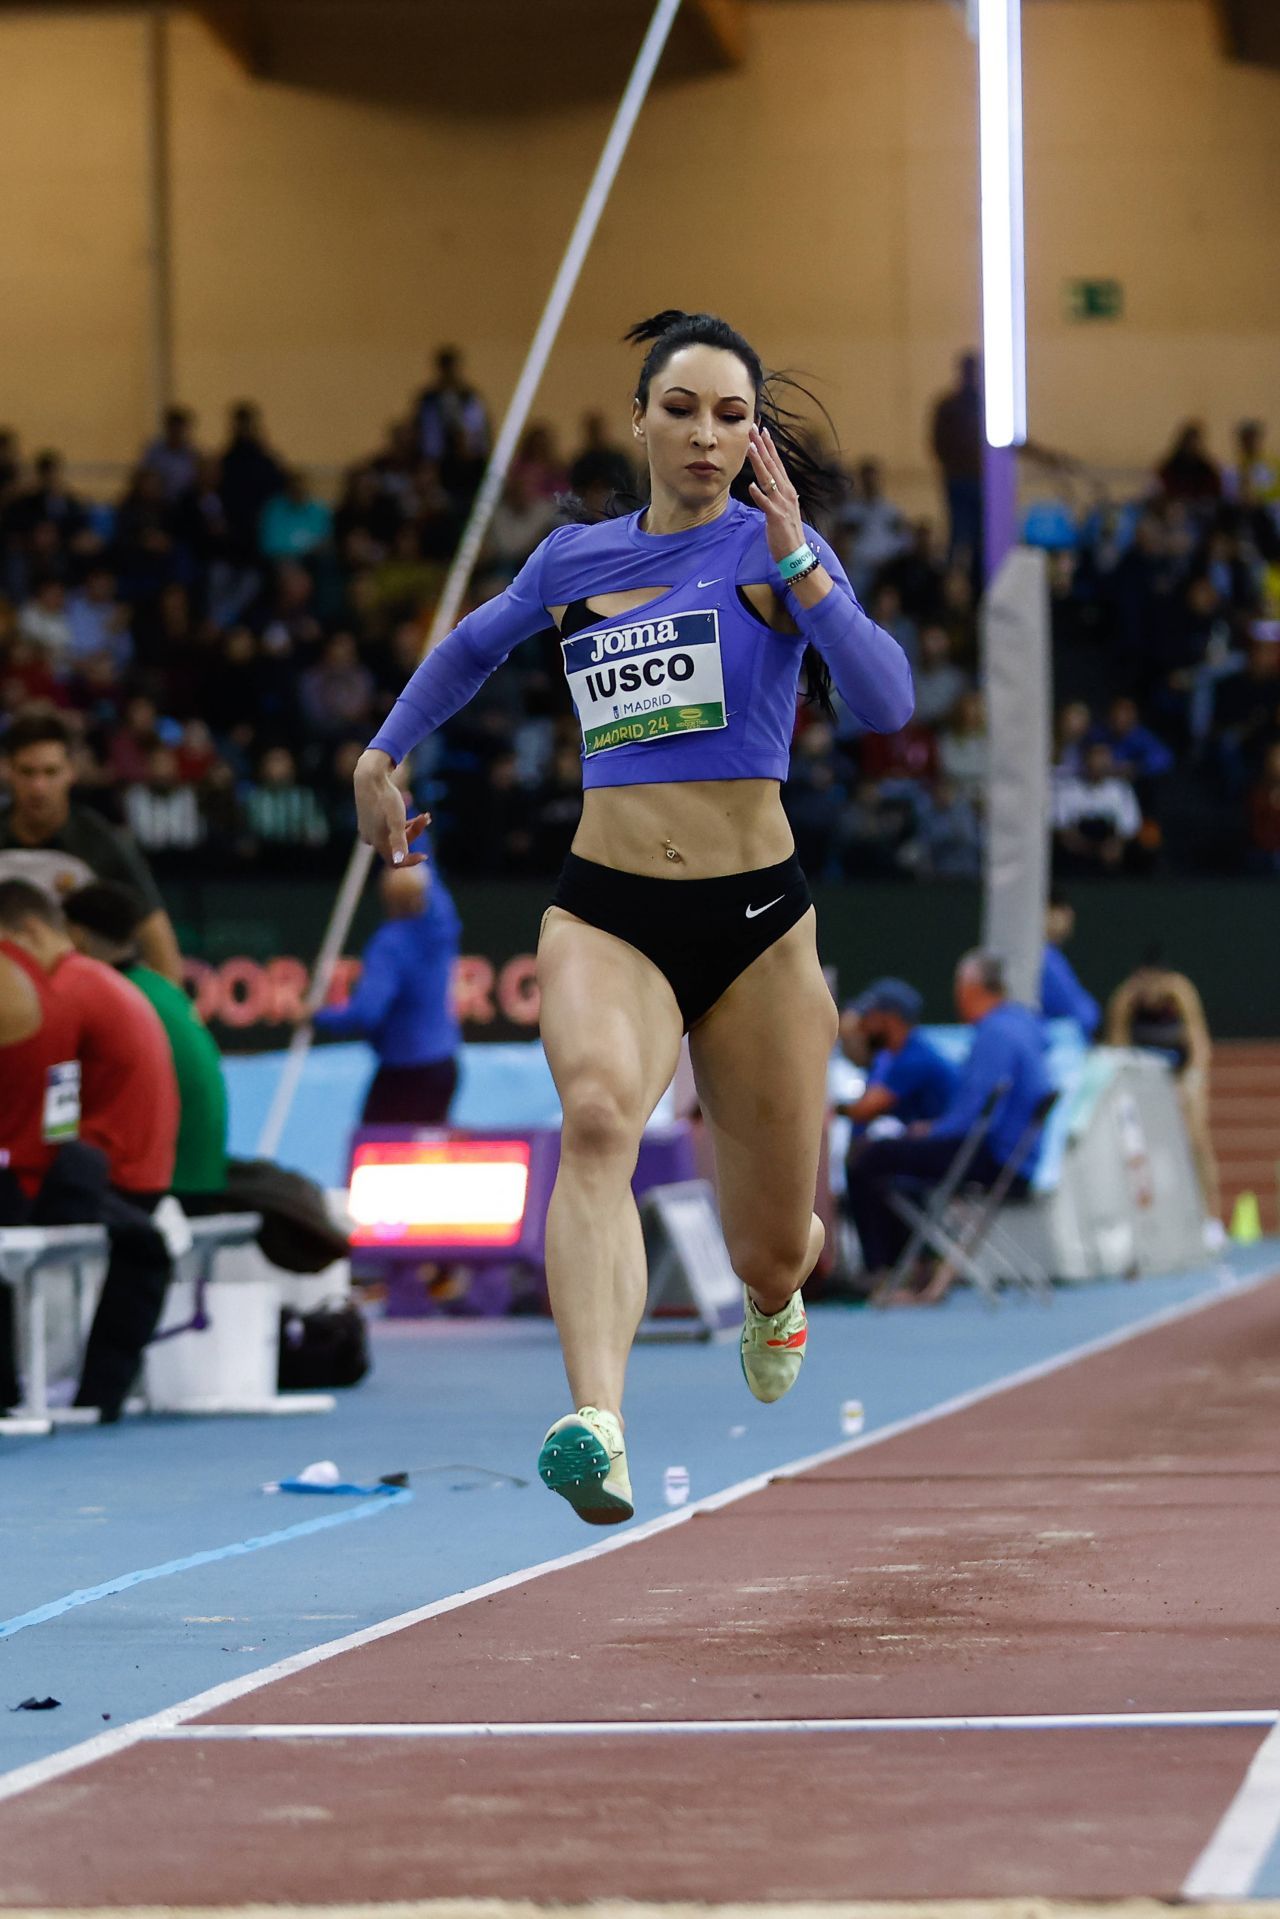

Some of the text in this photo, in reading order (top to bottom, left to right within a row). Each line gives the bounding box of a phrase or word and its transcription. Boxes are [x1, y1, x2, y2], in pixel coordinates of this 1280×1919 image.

[590, 620, 679, 662] Joma
[585, 653, 695, 702] IUSCO
[623, 693, 672, 715] MADRID
[593, 723, 644, 750] MADRID
[647, 715, 669, 735] 24
